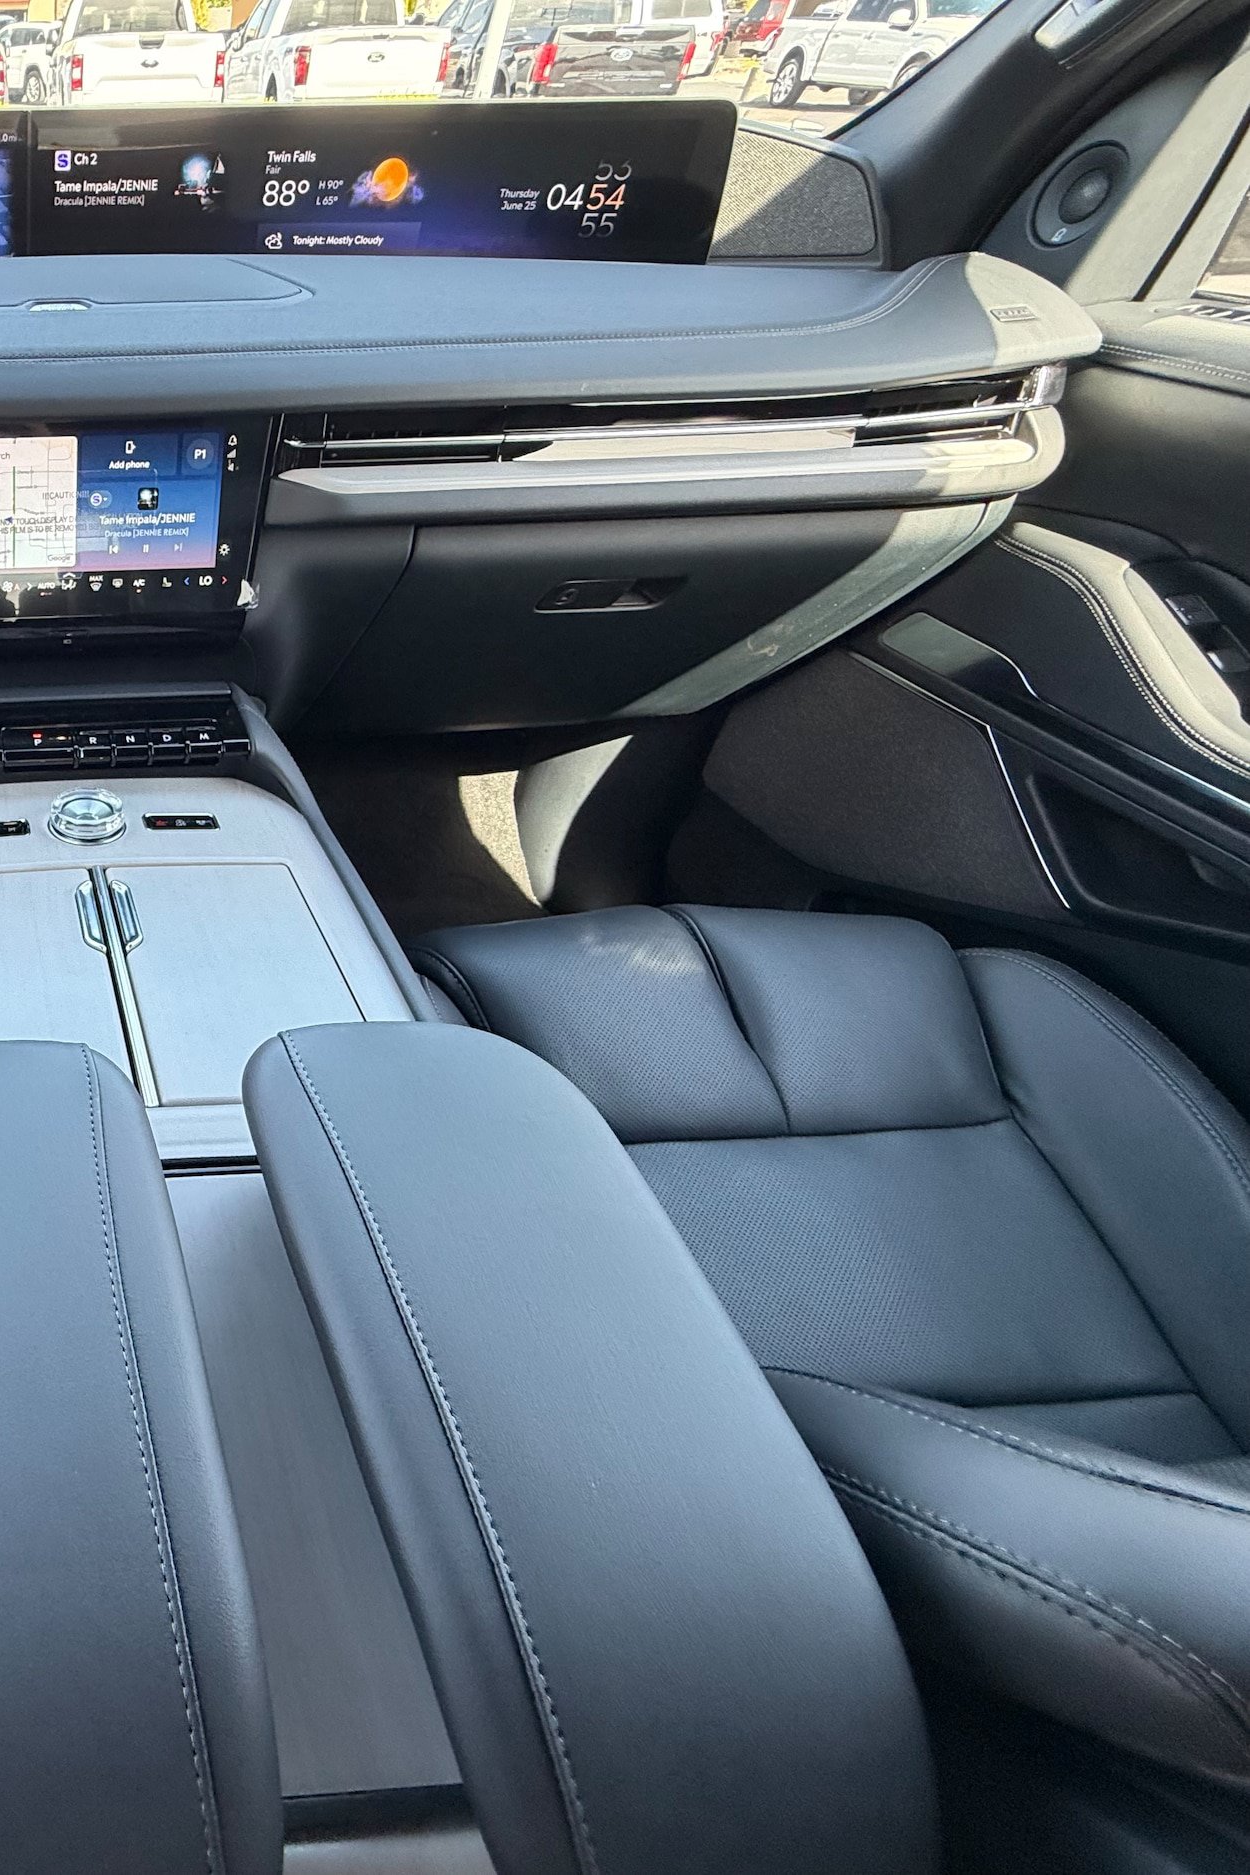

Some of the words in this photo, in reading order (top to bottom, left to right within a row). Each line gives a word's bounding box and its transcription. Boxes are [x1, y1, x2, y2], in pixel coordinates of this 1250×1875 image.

[74, 153, 89, 166] Ch
[90, 153, 98, 166] 2
[268, 150, 291, 163] Twin
[293, 150, 316, 163] Falls
[265, 165, 281, 175] Fair
[54, 180, 81, 193] Tame
[83, 178, 159, 195] Impala/JENNIE
[500, 188, 540, 200] Thursday
[546, 183, 584, 211] 04
[586, 183, 628, 211] 54
[54, 196, 83, 206] Dracula
[84, 195, 116, 207] [JENNIE
[117, 194, 145, 207] REMIX]
[501, 201, 522, 211] June
[523, 201, 537, 210] 25
[577, 212, 618, 238] 55
[293, 235, 325, 247] Tonight:
[326, 234, 353, 247] Mostly
[354, 234, 384, 247] Cloudy
[194, 449, 206, 460] P1
[109, 461, 124, 470] Add
[125, 460, 150, 470] phone
[16, 517, 38, 526] TOUCH
[99, 516, 124, 526] Tame
[126, 513, 196, 527] Impala/JENNIE
[104, 529, 131, 538] Dracula
[163, 527, 189, 536] REMIX]
[47, 555, 72, 563] Google
[133, 579, 146, 588] A/C
[199, 575, 213, 586] LO
[37, 582, 56, 590] AUTO
[89, 737, 97, 745] R
[125, 735, 136, 743] N
[162, 734, 172, 742] D
[199, 733, 210, 741] M
[33, 738, 42, 747] P
